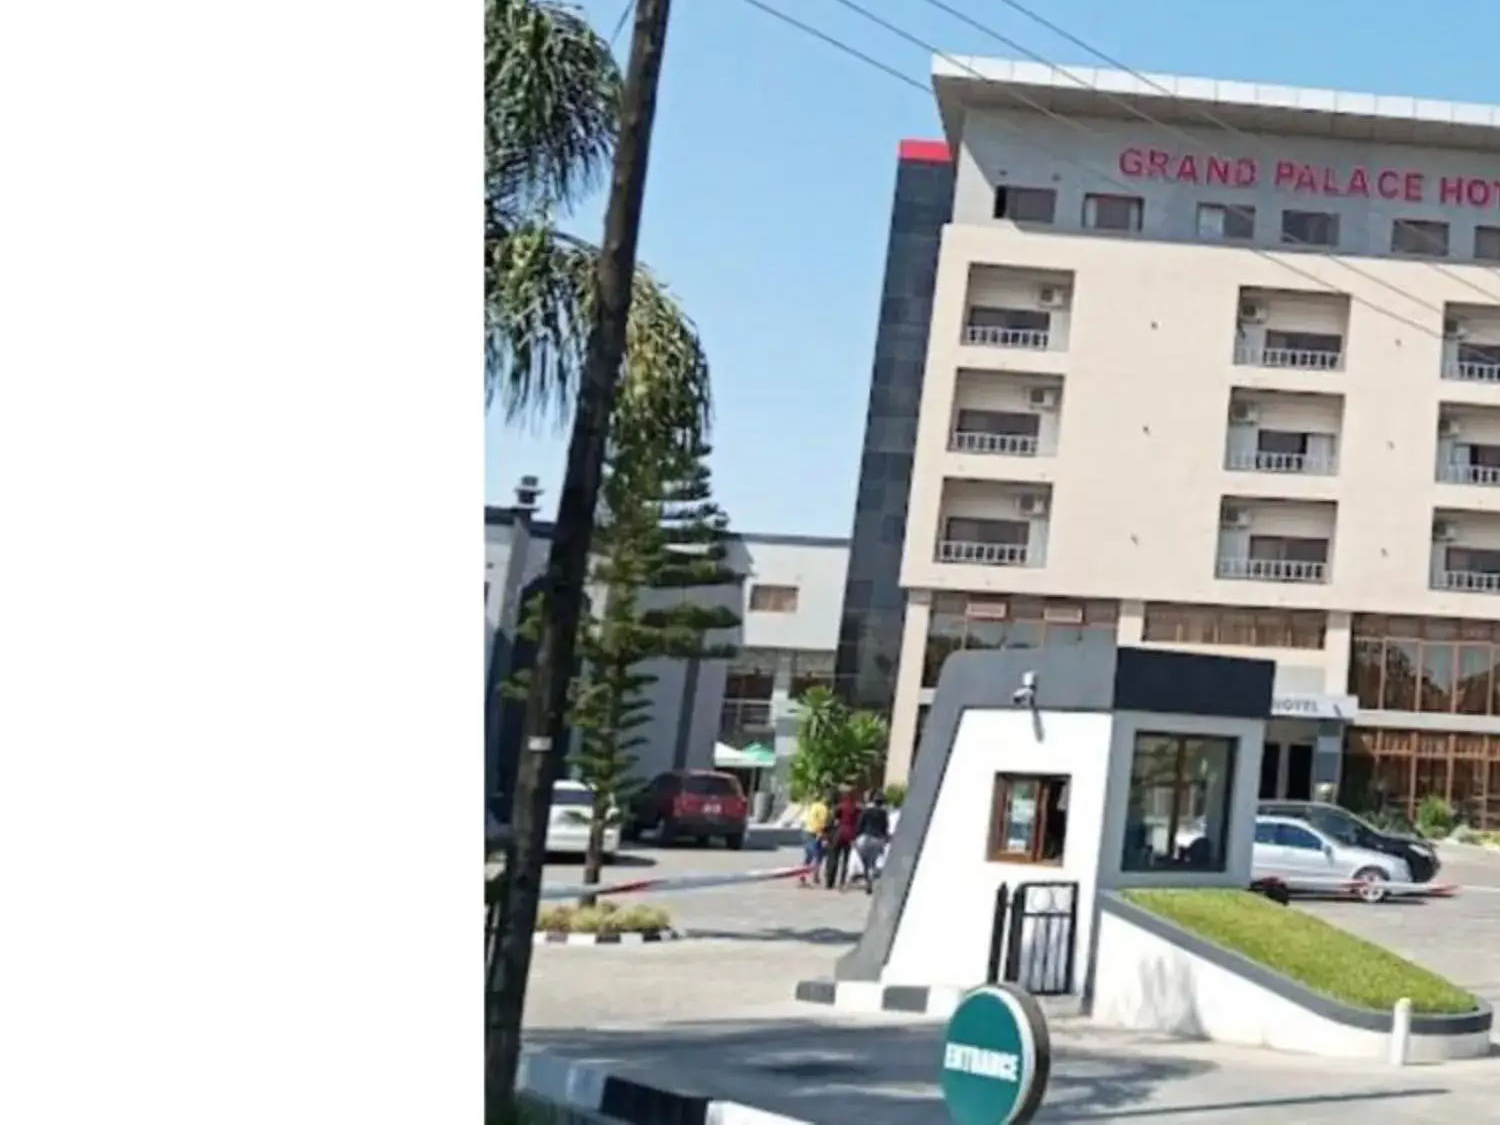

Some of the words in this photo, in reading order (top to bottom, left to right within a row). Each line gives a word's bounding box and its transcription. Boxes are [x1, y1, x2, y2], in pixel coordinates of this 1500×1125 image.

[1118, 147, 1258, 188] GRAND
[1273, 158, 1425, 203] PALACE
[943, 1041, 1019, 1083] ENTRANCE
